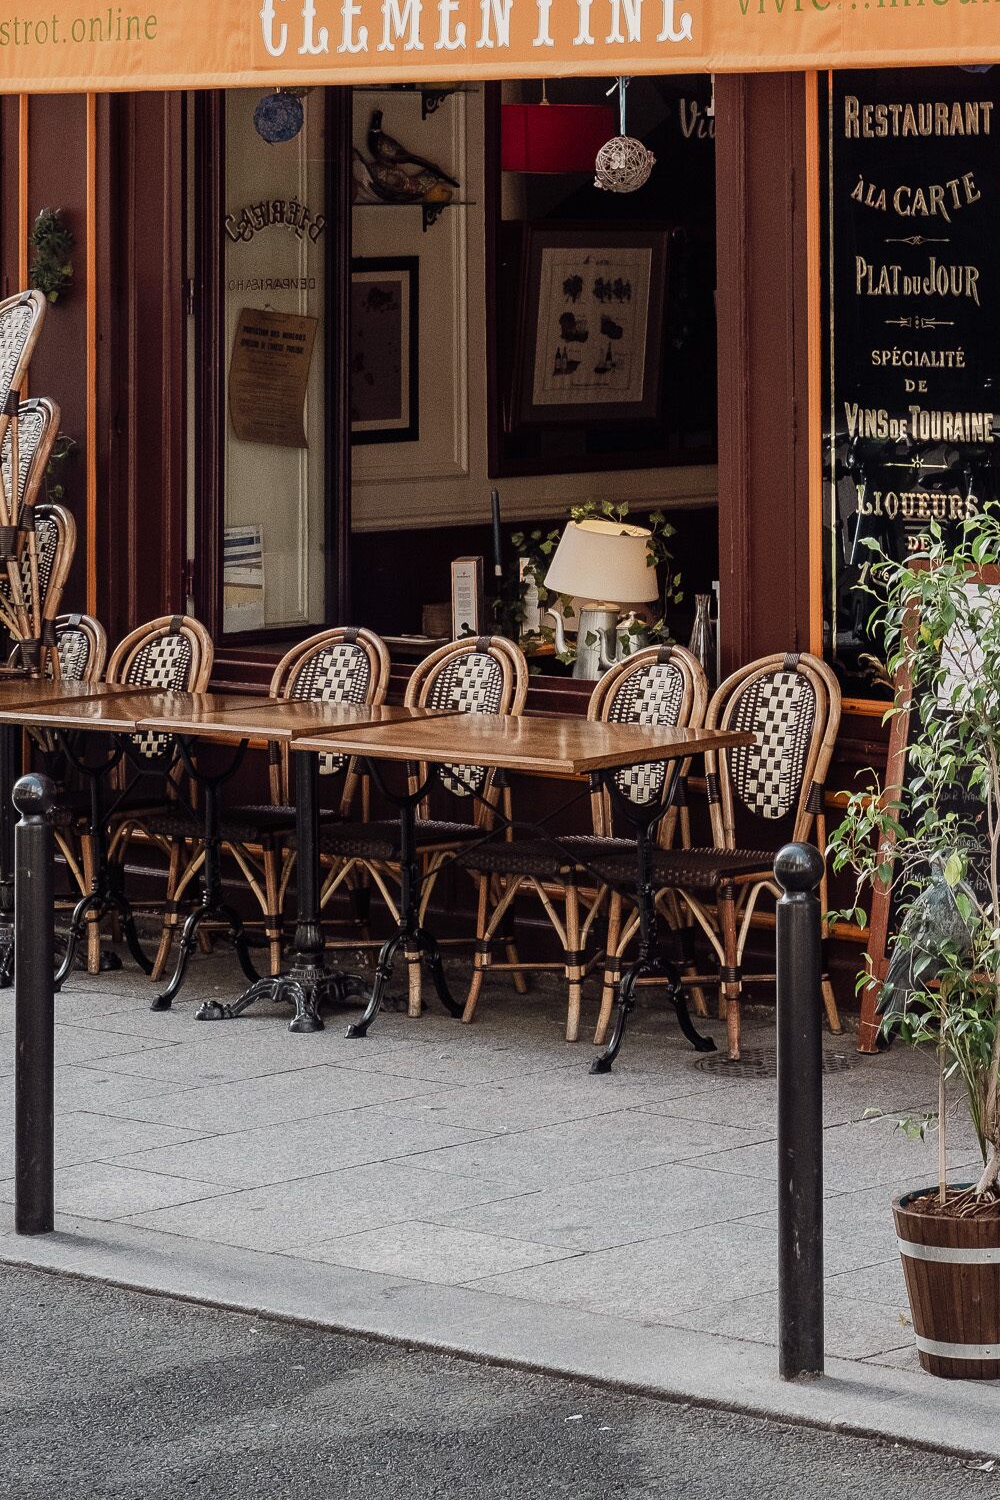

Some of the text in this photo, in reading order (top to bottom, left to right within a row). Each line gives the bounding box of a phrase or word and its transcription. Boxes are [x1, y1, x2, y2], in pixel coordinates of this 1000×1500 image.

[844, 95, 994, 138] RESTAURANT
[864, 183, 887, 211] LA
[893, 172, 981, 223] CARTE
[856, 255, 980, 307] PLAT DU JOUR
[871, 346, 966, 368] SPÉCIALITÉ
[905, 379, 928, 393] DE
[844, 402, 995, 442] VINS DE TOURAINE
[856, 484, 979, 520] LIQUEURS
[908, 534, 931, 551] DE
